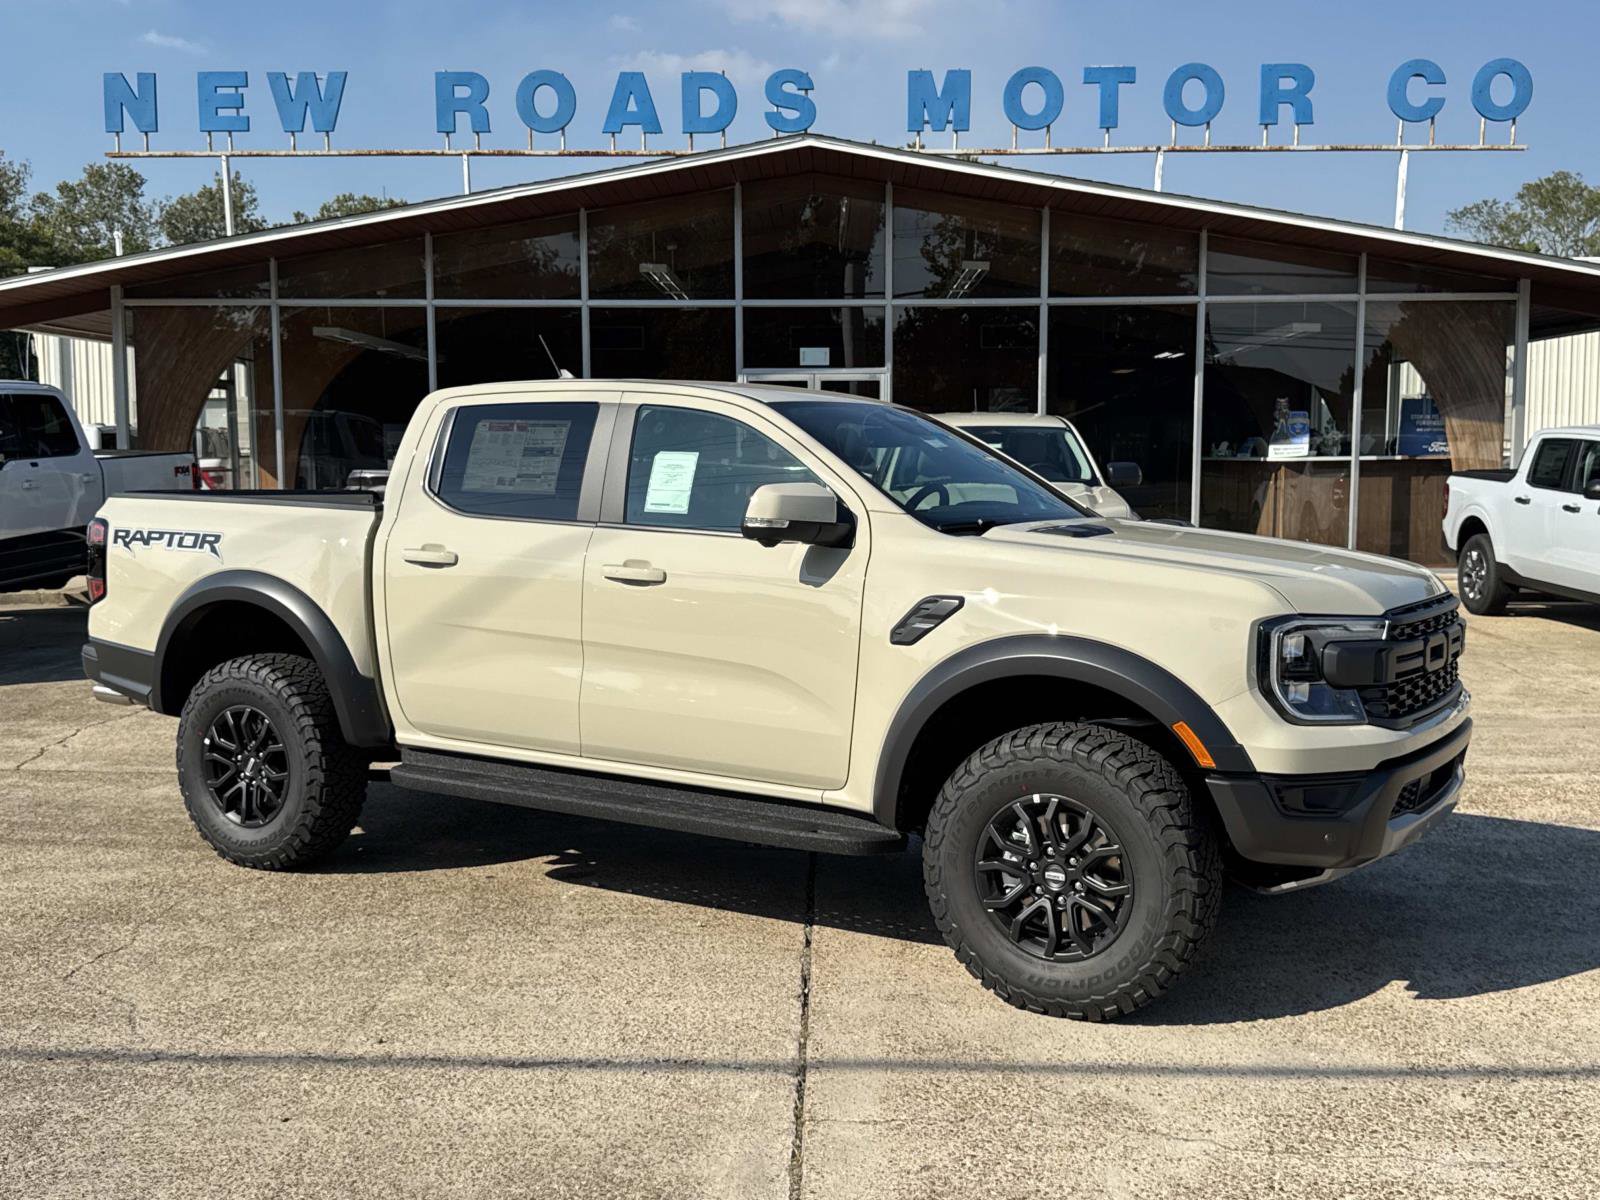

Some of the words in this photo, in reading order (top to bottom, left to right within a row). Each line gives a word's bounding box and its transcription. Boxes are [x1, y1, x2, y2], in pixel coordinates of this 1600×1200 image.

[104, 71, 347, 134] NEW
[436, 69, 817, 134] ROADS
[907, 62, 1316, 132] MOTOR
[1387, 58, 1533, 123] CO
[113, 529, 222, 559] RAPTOR
[1386, 619, 1465, 684] FOR
